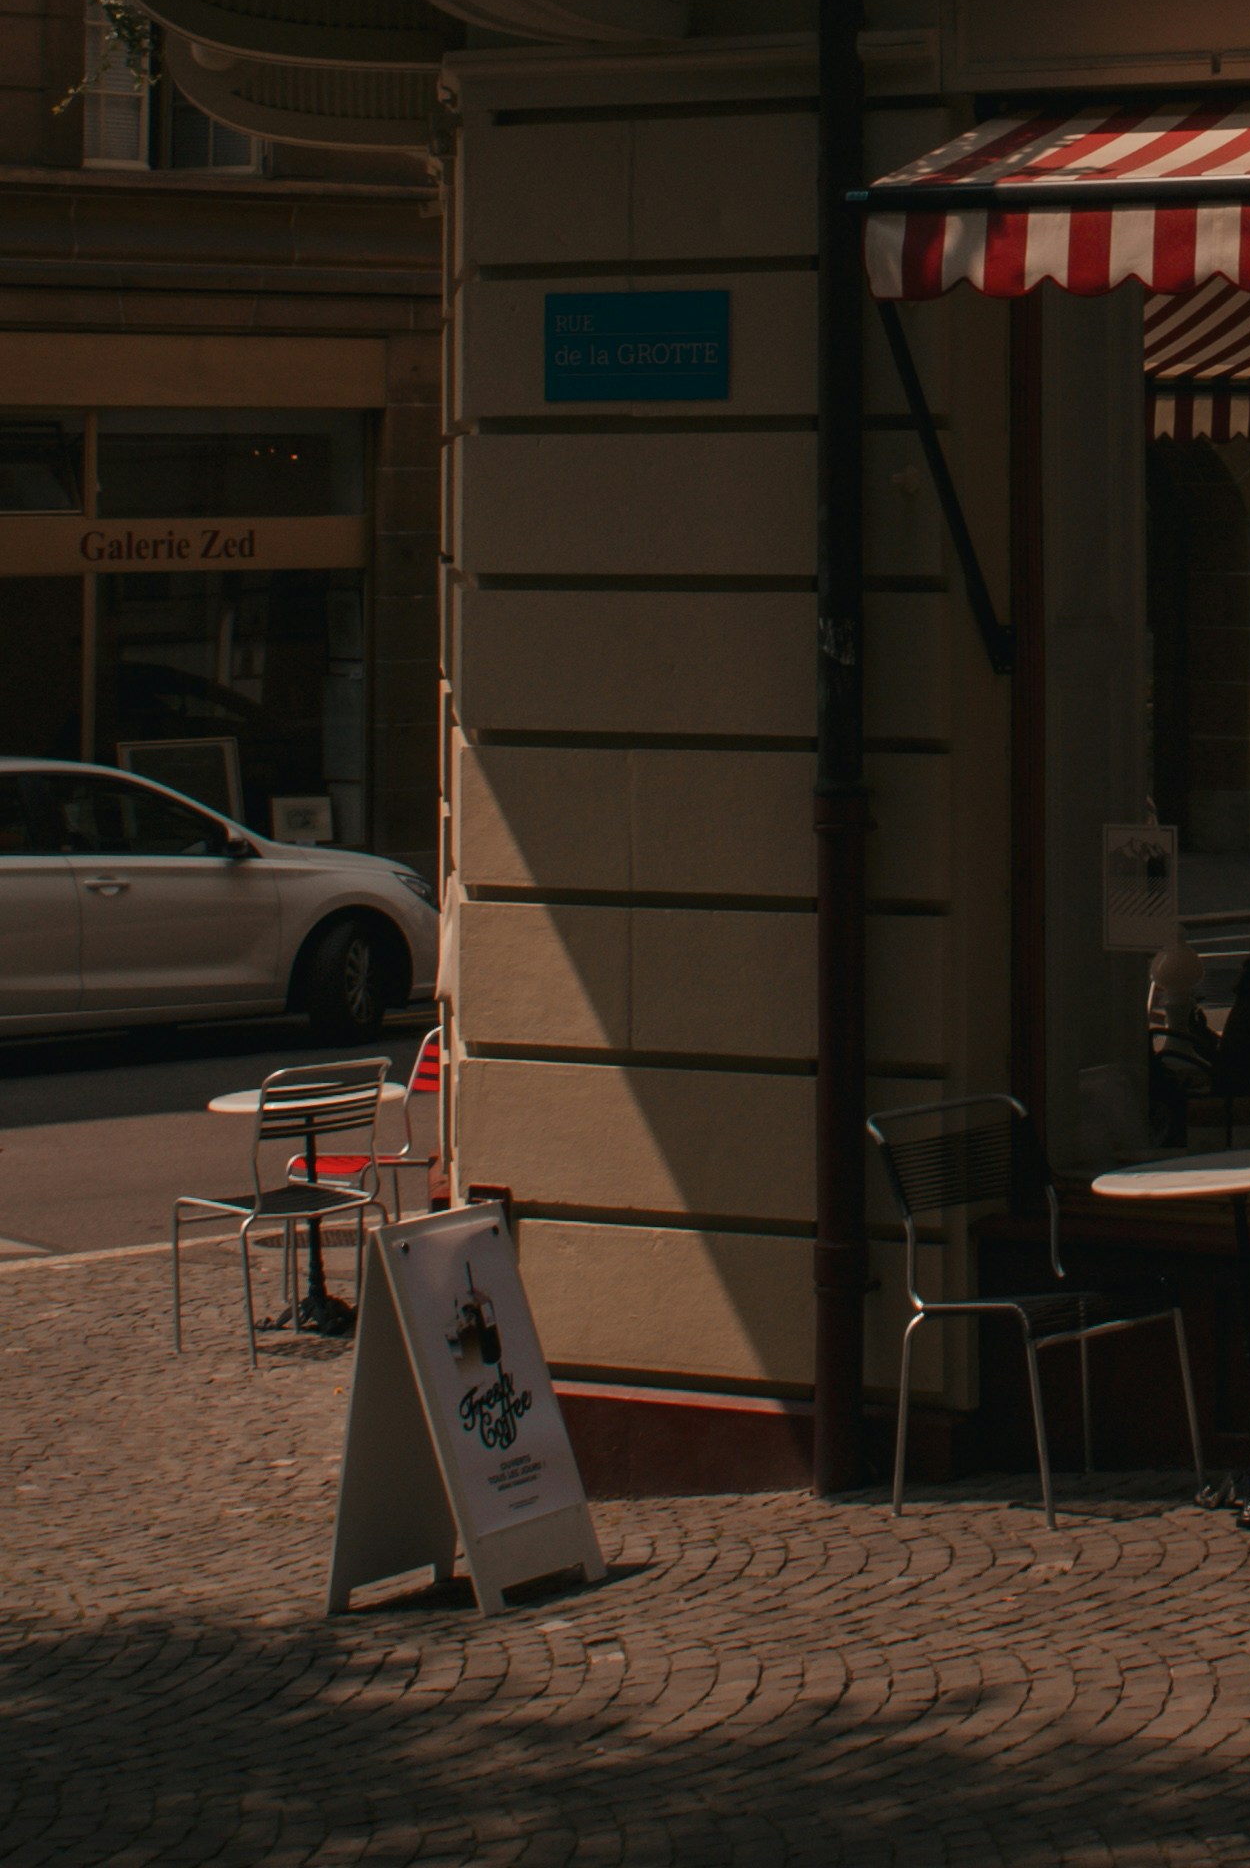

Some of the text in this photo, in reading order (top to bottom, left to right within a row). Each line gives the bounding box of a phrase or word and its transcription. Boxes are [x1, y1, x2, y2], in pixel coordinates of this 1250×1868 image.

[554, 314, 595, 333] RUE
[554, 342, 720, 366] de la GROTTE
[80, 529, 256, 562] Galerie Zed
[480, 1389, 532, 1450] Coffee
